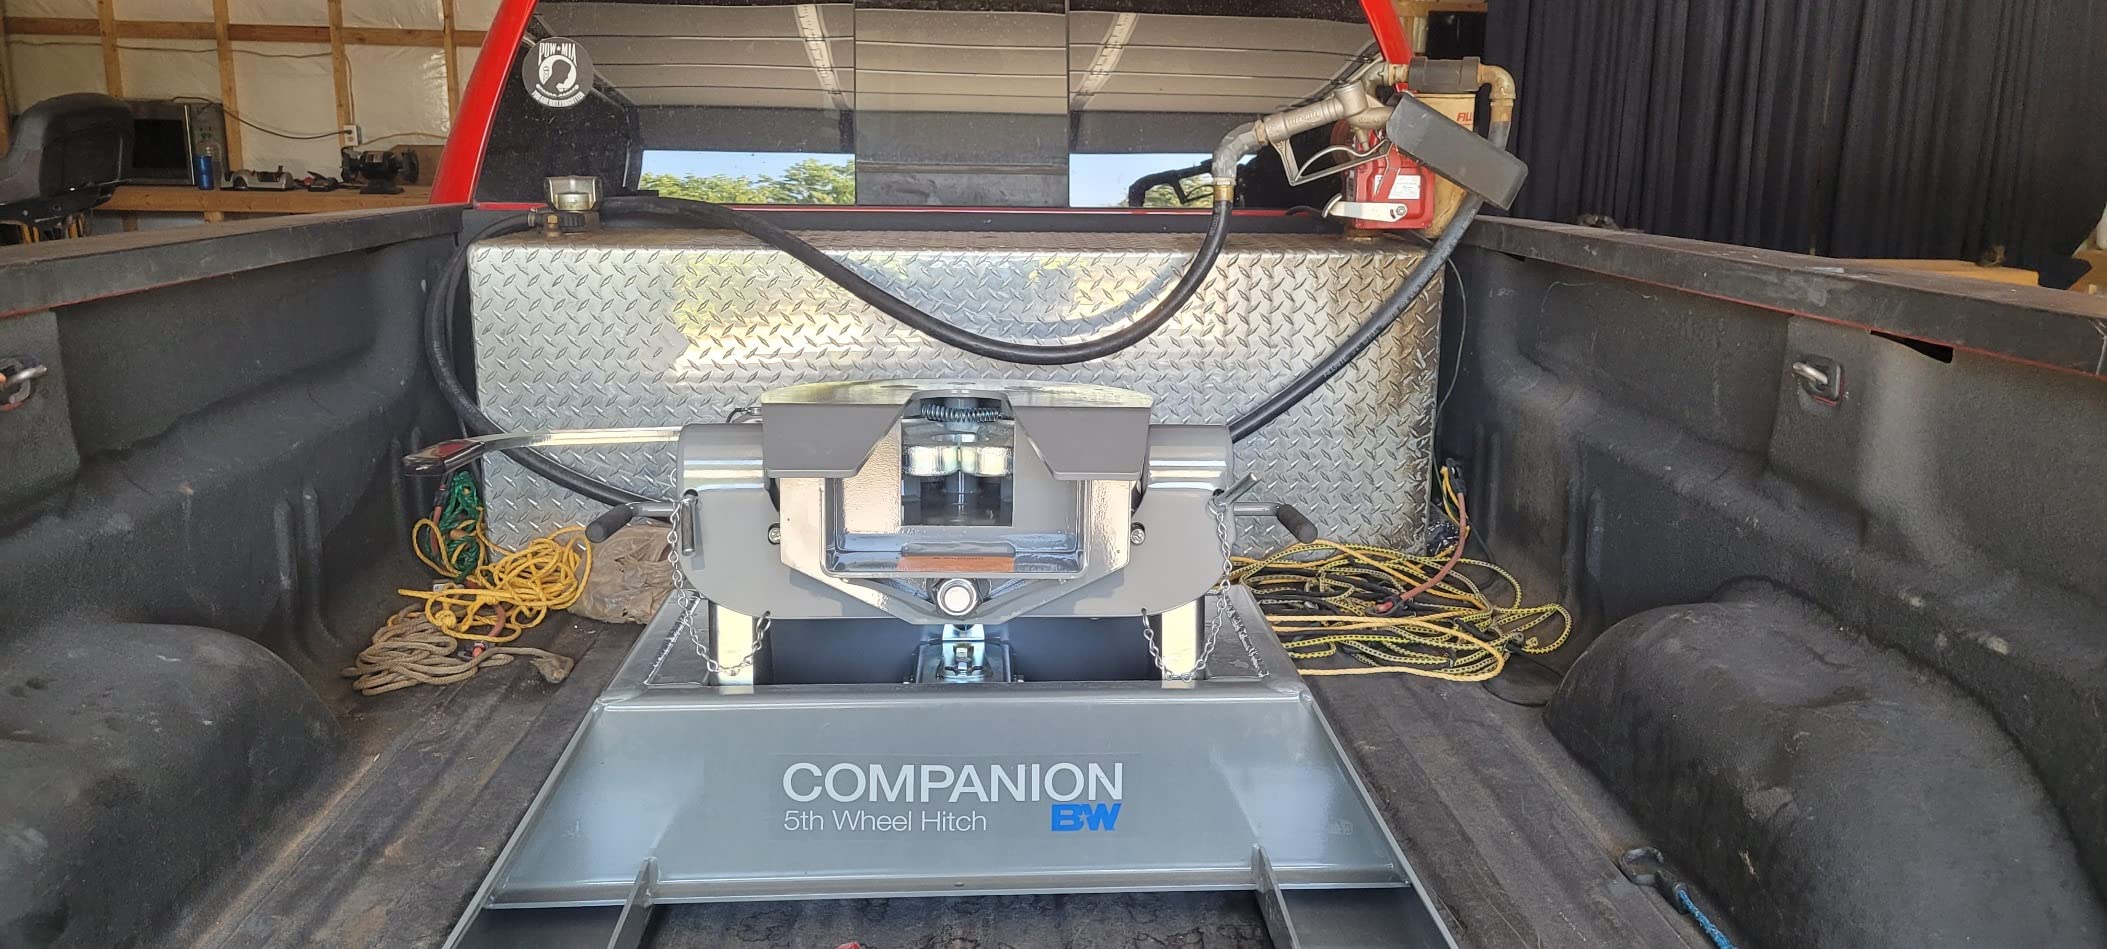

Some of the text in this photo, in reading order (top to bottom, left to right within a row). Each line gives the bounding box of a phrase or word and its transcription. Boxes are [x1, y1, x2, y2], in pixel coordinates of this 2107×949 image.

[538, 42, 578, 67] POW MIA
[782, 762, 1123, 802] COMPANION
[783, 809, 987, 832] 5th Wheel Hitch
